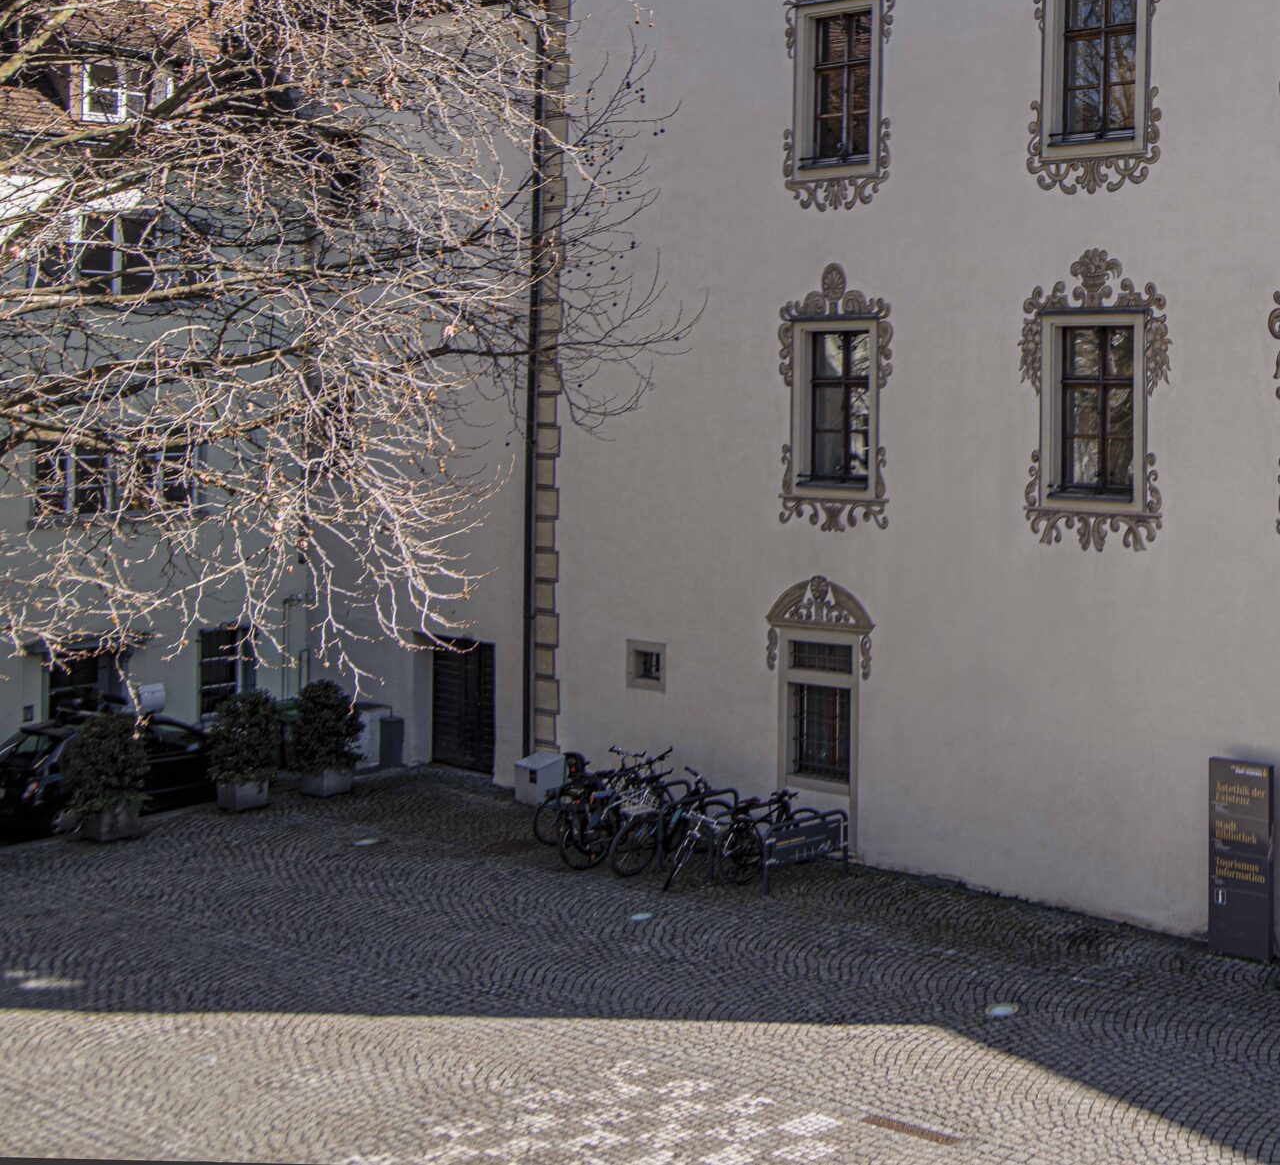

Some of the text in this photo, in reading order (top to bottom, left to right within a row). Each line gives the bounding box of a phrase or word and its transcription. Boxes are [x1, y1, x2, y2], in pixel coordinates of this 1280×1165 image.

[1215, 820, 1237, 831] Stadt
[1216, 857, 1259, 873] Tourismus
[1216, 867, 1265, 884] Information
